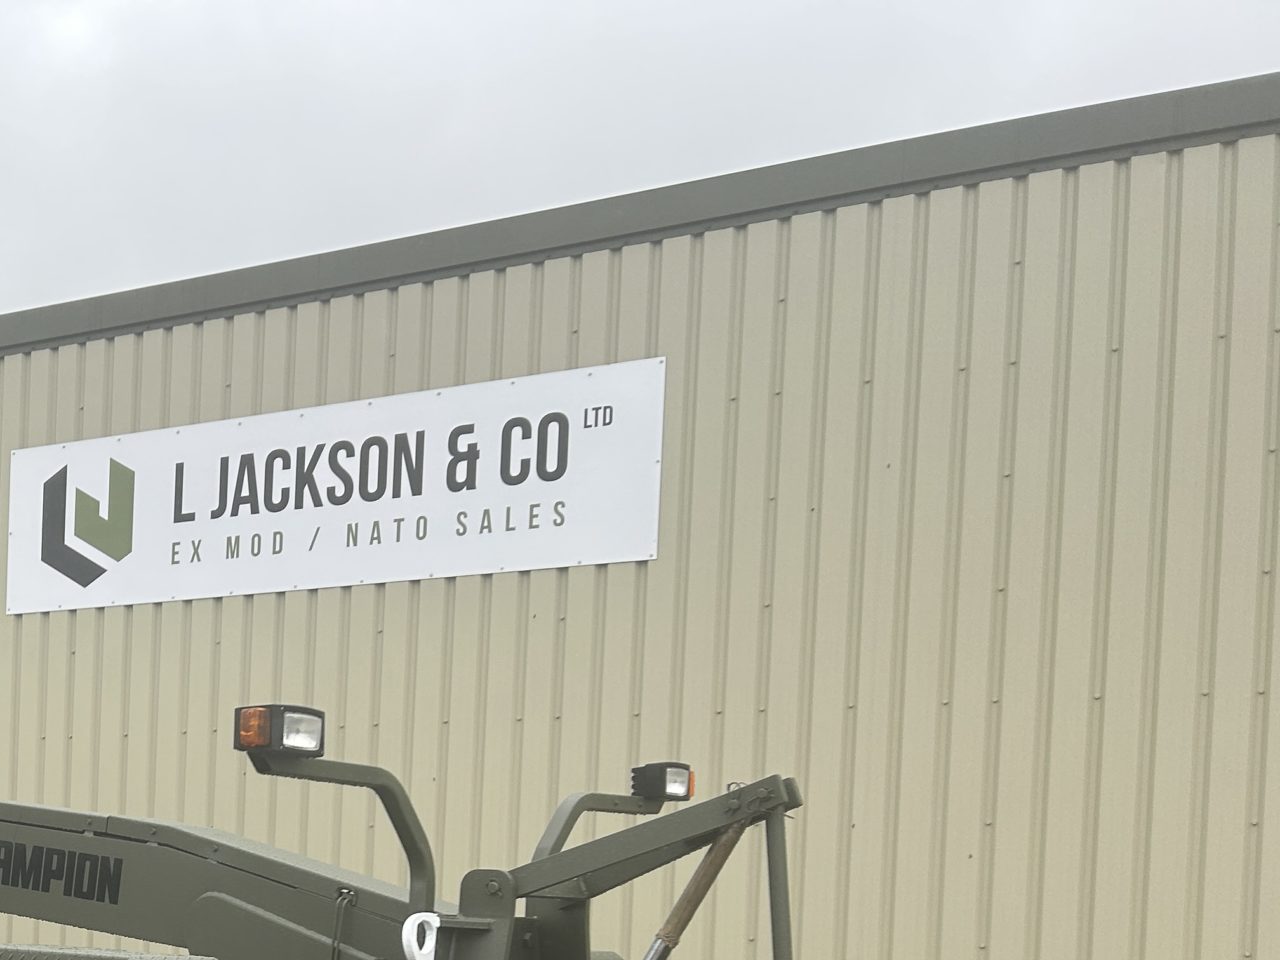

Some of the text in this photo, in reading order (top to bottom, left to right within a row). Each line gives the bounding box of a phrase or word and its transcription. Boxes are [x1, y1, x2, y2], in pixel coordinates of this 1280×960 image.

[583, 405, 614, 429] LTD
[173, 411, 570, 524] L JACKSON & CO
[171, 501, 566, 565] EX MOD / NATO SALES
